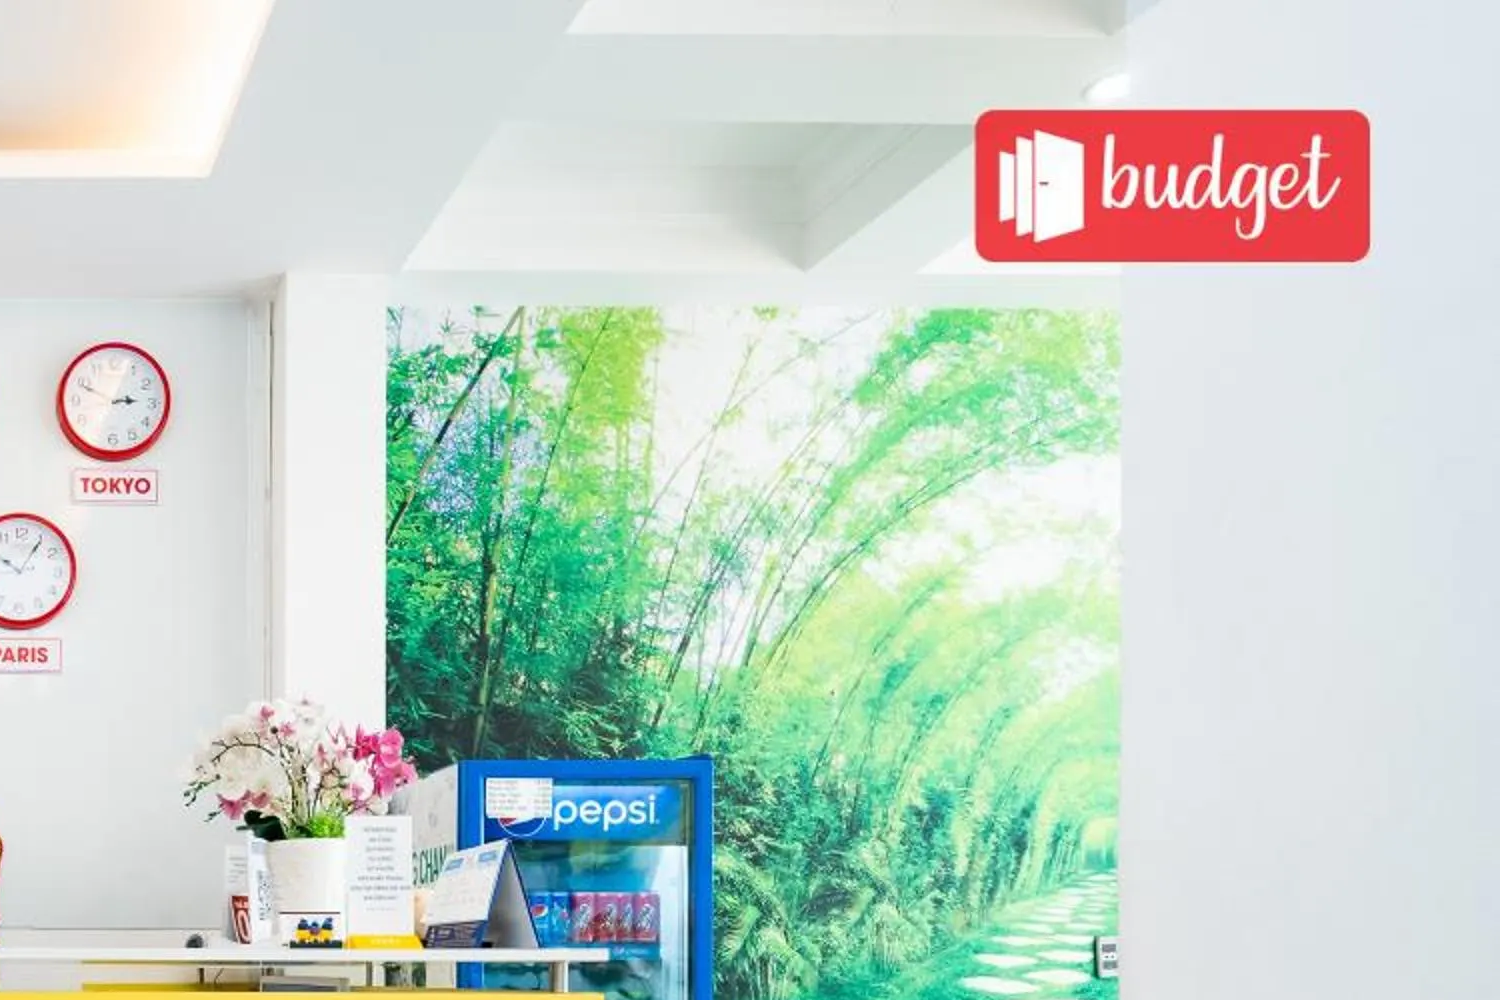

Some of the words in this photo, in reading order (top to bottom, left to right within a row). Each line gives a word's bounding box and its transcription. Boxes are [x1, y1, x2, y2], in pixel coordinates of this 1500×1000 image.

[140, 377, 151, 390] 2
[147, 397, 157, 410] 3
[107, 432, 118, 446] 6
[79, 476, 152, 495] TOKYO
[15, 527, 29, 541] 12
[47, 547, 57, 559] 2
[553, 794, 656, 832] pepsi
